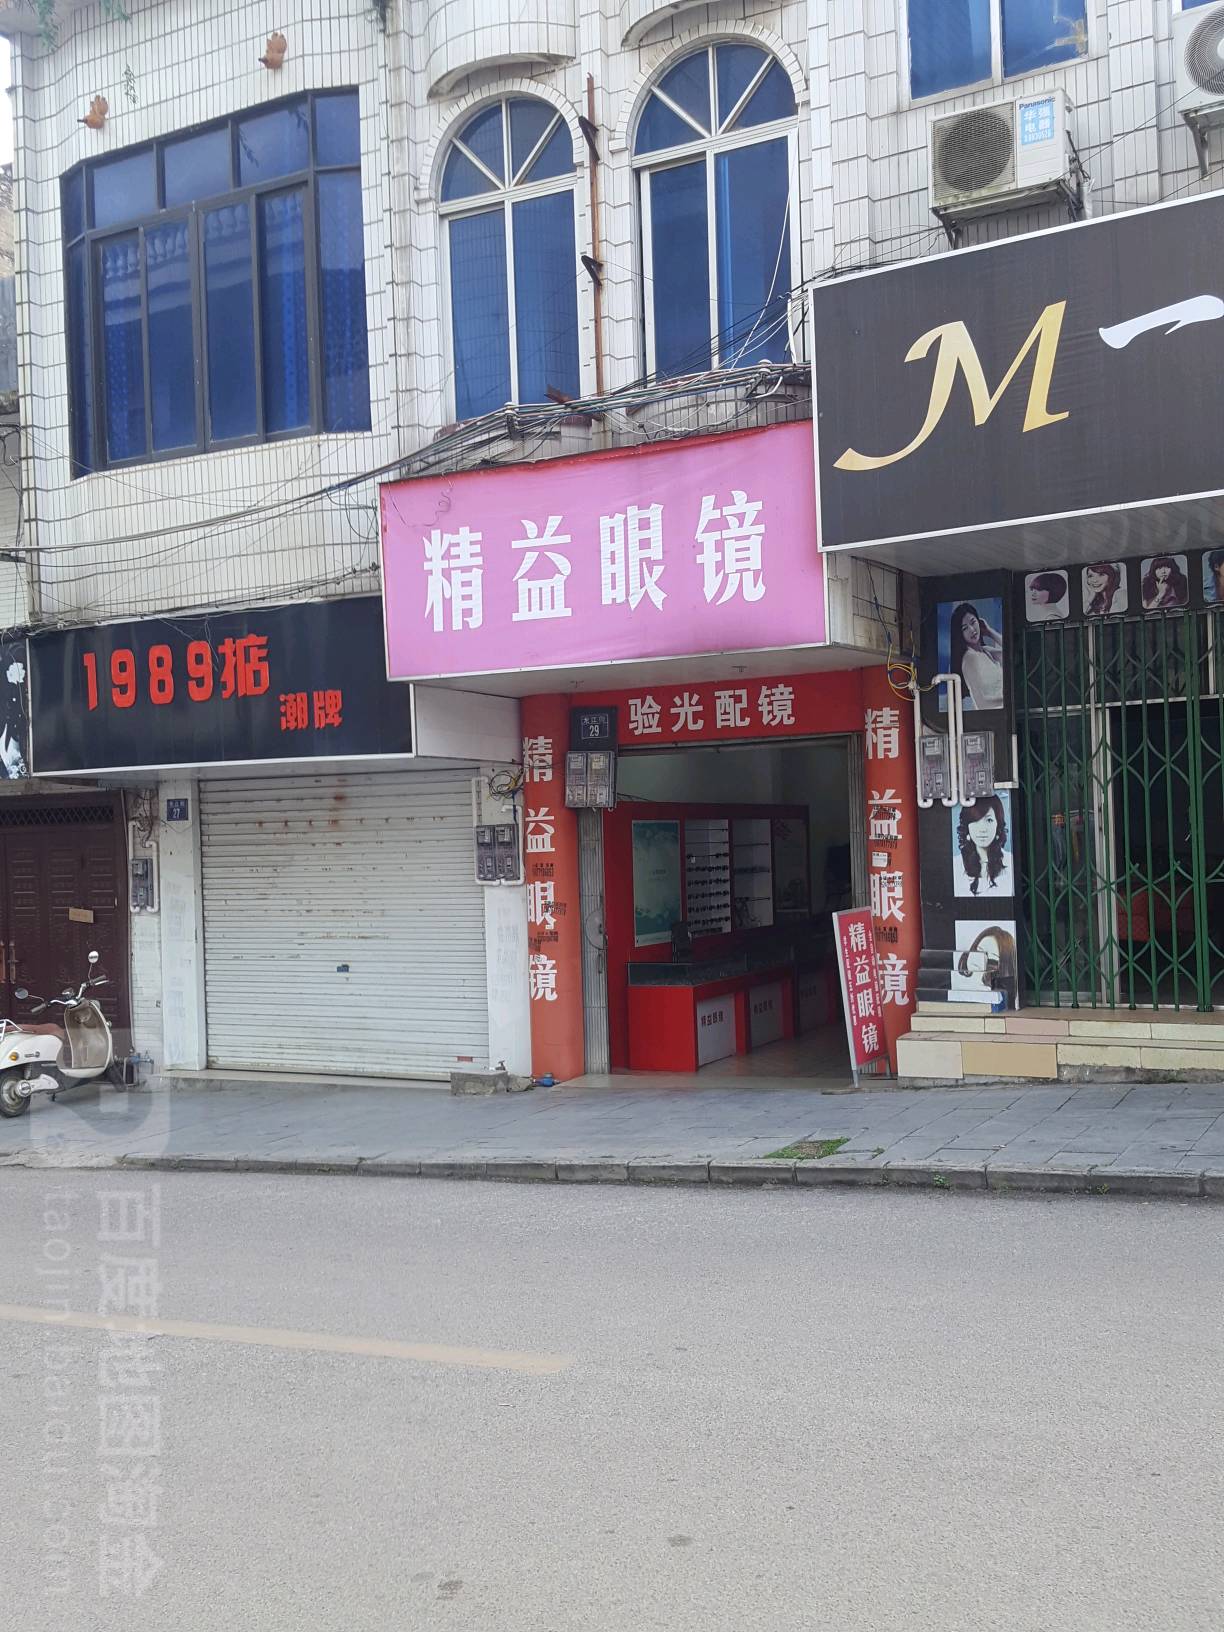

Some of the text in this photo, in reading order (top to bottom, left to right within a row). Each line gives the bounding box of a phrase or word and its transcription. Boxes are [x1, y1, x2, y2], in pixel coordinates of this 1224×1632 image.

[1019, 96, 1055, 109] Panasonic
[833, 300, 1069, 471] M
[423, 490, 766, 632] 精益眼镜
[280, 689, 343, 731] 潮牌
[589, 724, 600, 737] 29
[628, 683, 795, 736] 验光配镜
[848, 922, 879, 1054] 精益眼镜
